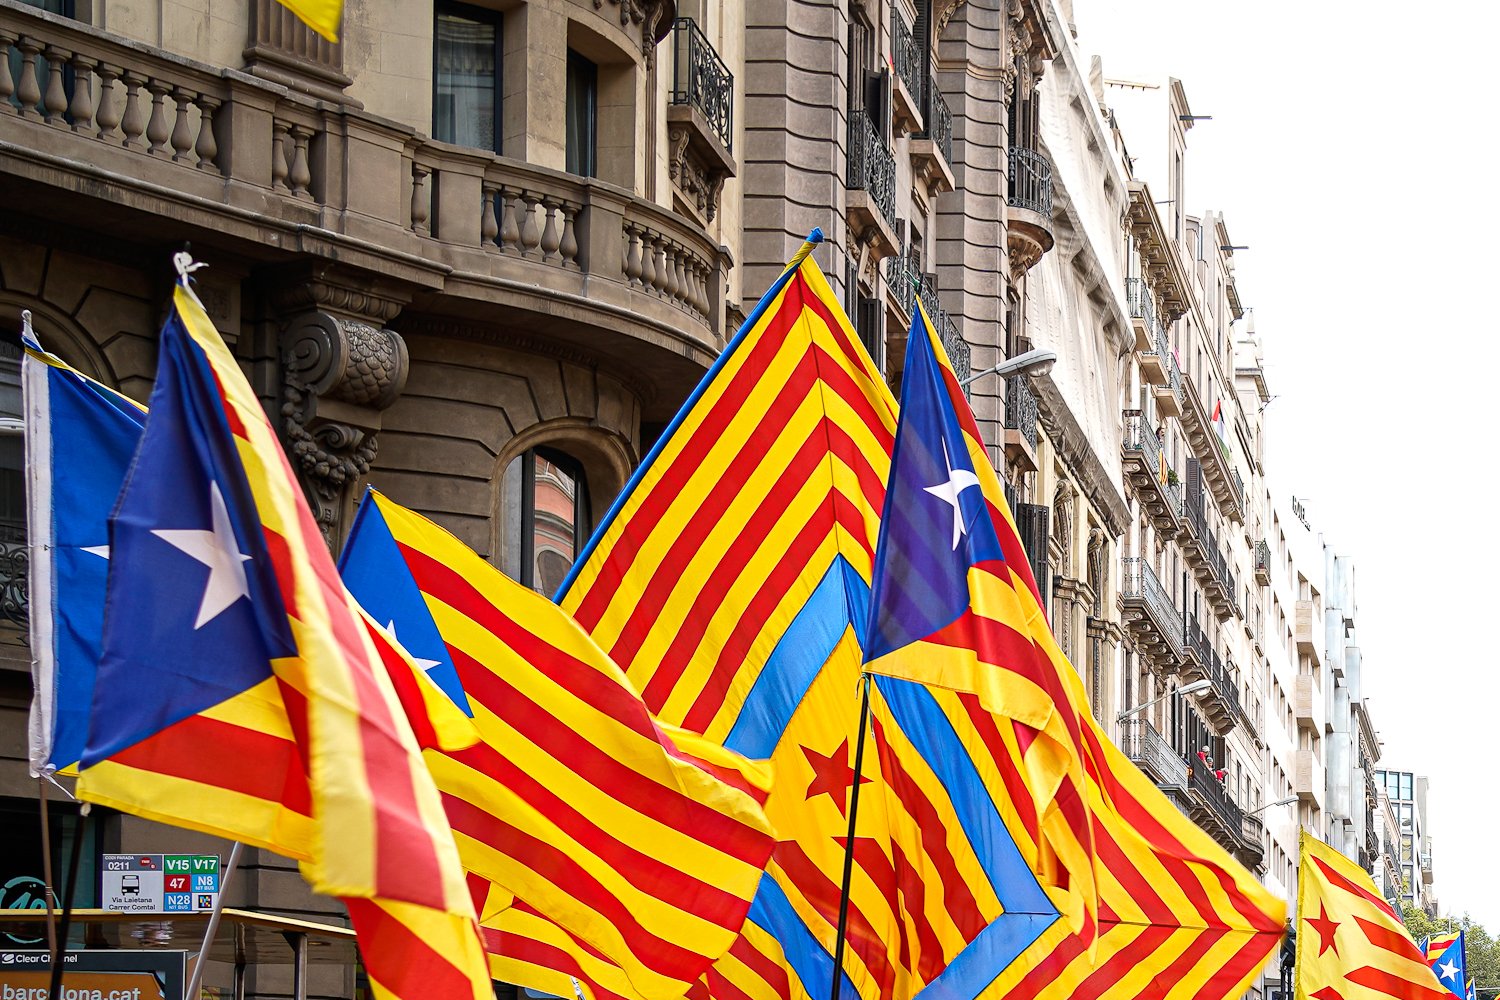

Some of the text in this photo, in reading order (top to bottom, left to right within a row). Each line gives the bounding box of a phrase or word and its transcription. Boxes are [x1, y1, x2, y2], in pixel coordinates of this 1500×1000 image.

[108, 861, 130, 870] 0211
[166, 859, 217, 870] V15 V17
[169, 878, 185, 889] 47
[198, 876, 213, 886] N8
[168, 895, 190, 905] N28
[15, 954, 78, 963] Clear Chnel
